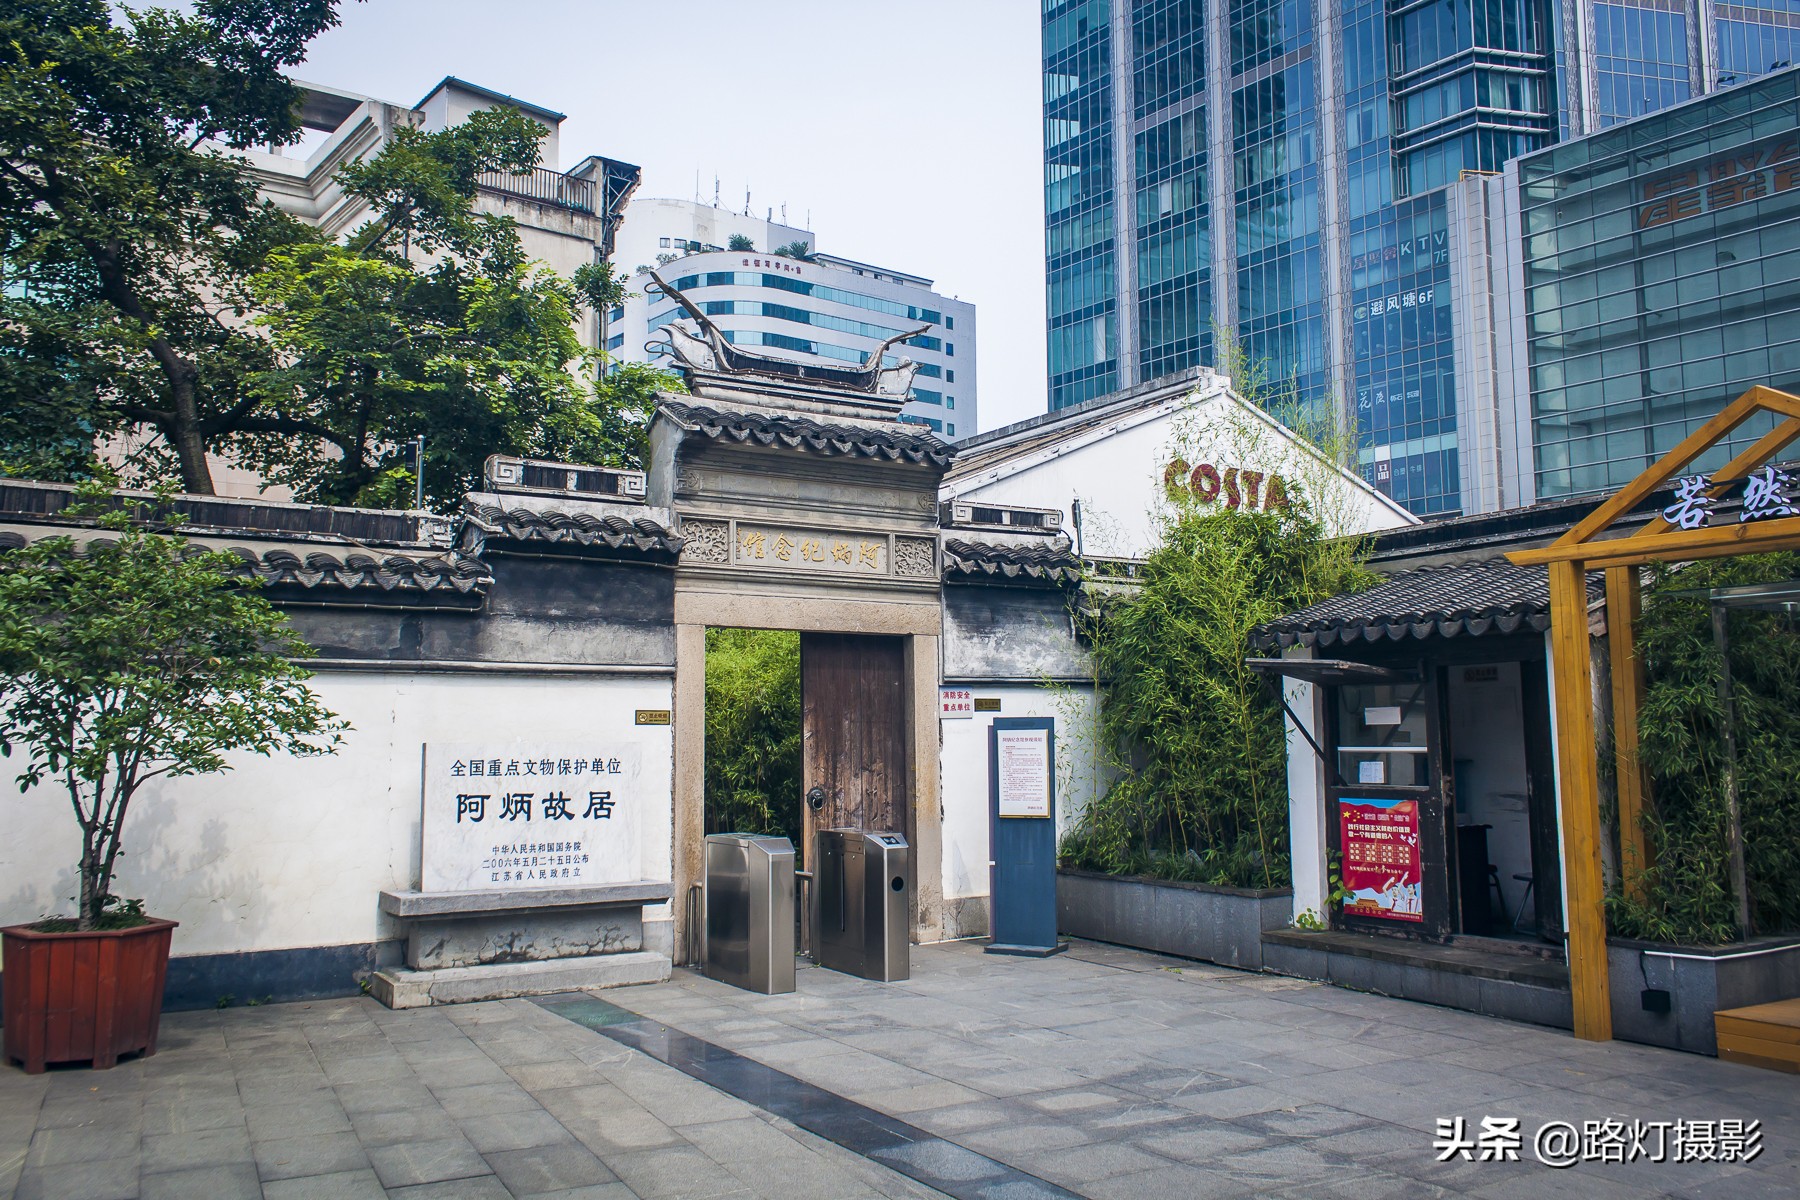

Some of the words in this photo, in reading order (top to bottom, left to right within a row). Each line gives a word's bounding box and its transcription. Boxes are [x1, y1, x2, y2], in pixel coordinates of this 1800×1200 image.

[1433, 248, 1448, 265] 7F
[1164, 459, 1290, 512] COSTA
[942, 690, 971, 700] 消防安全
[942, 703, 971, 712] 重点单位
[450, 757, 622, 777] 全国重点文物保护单位
[456, 790, 616, 824] 阿炳故居
[491, 841, 582, 855] 中华人民共和国国务院
[491, 867, 582, 882] 江苏省人民政府立
